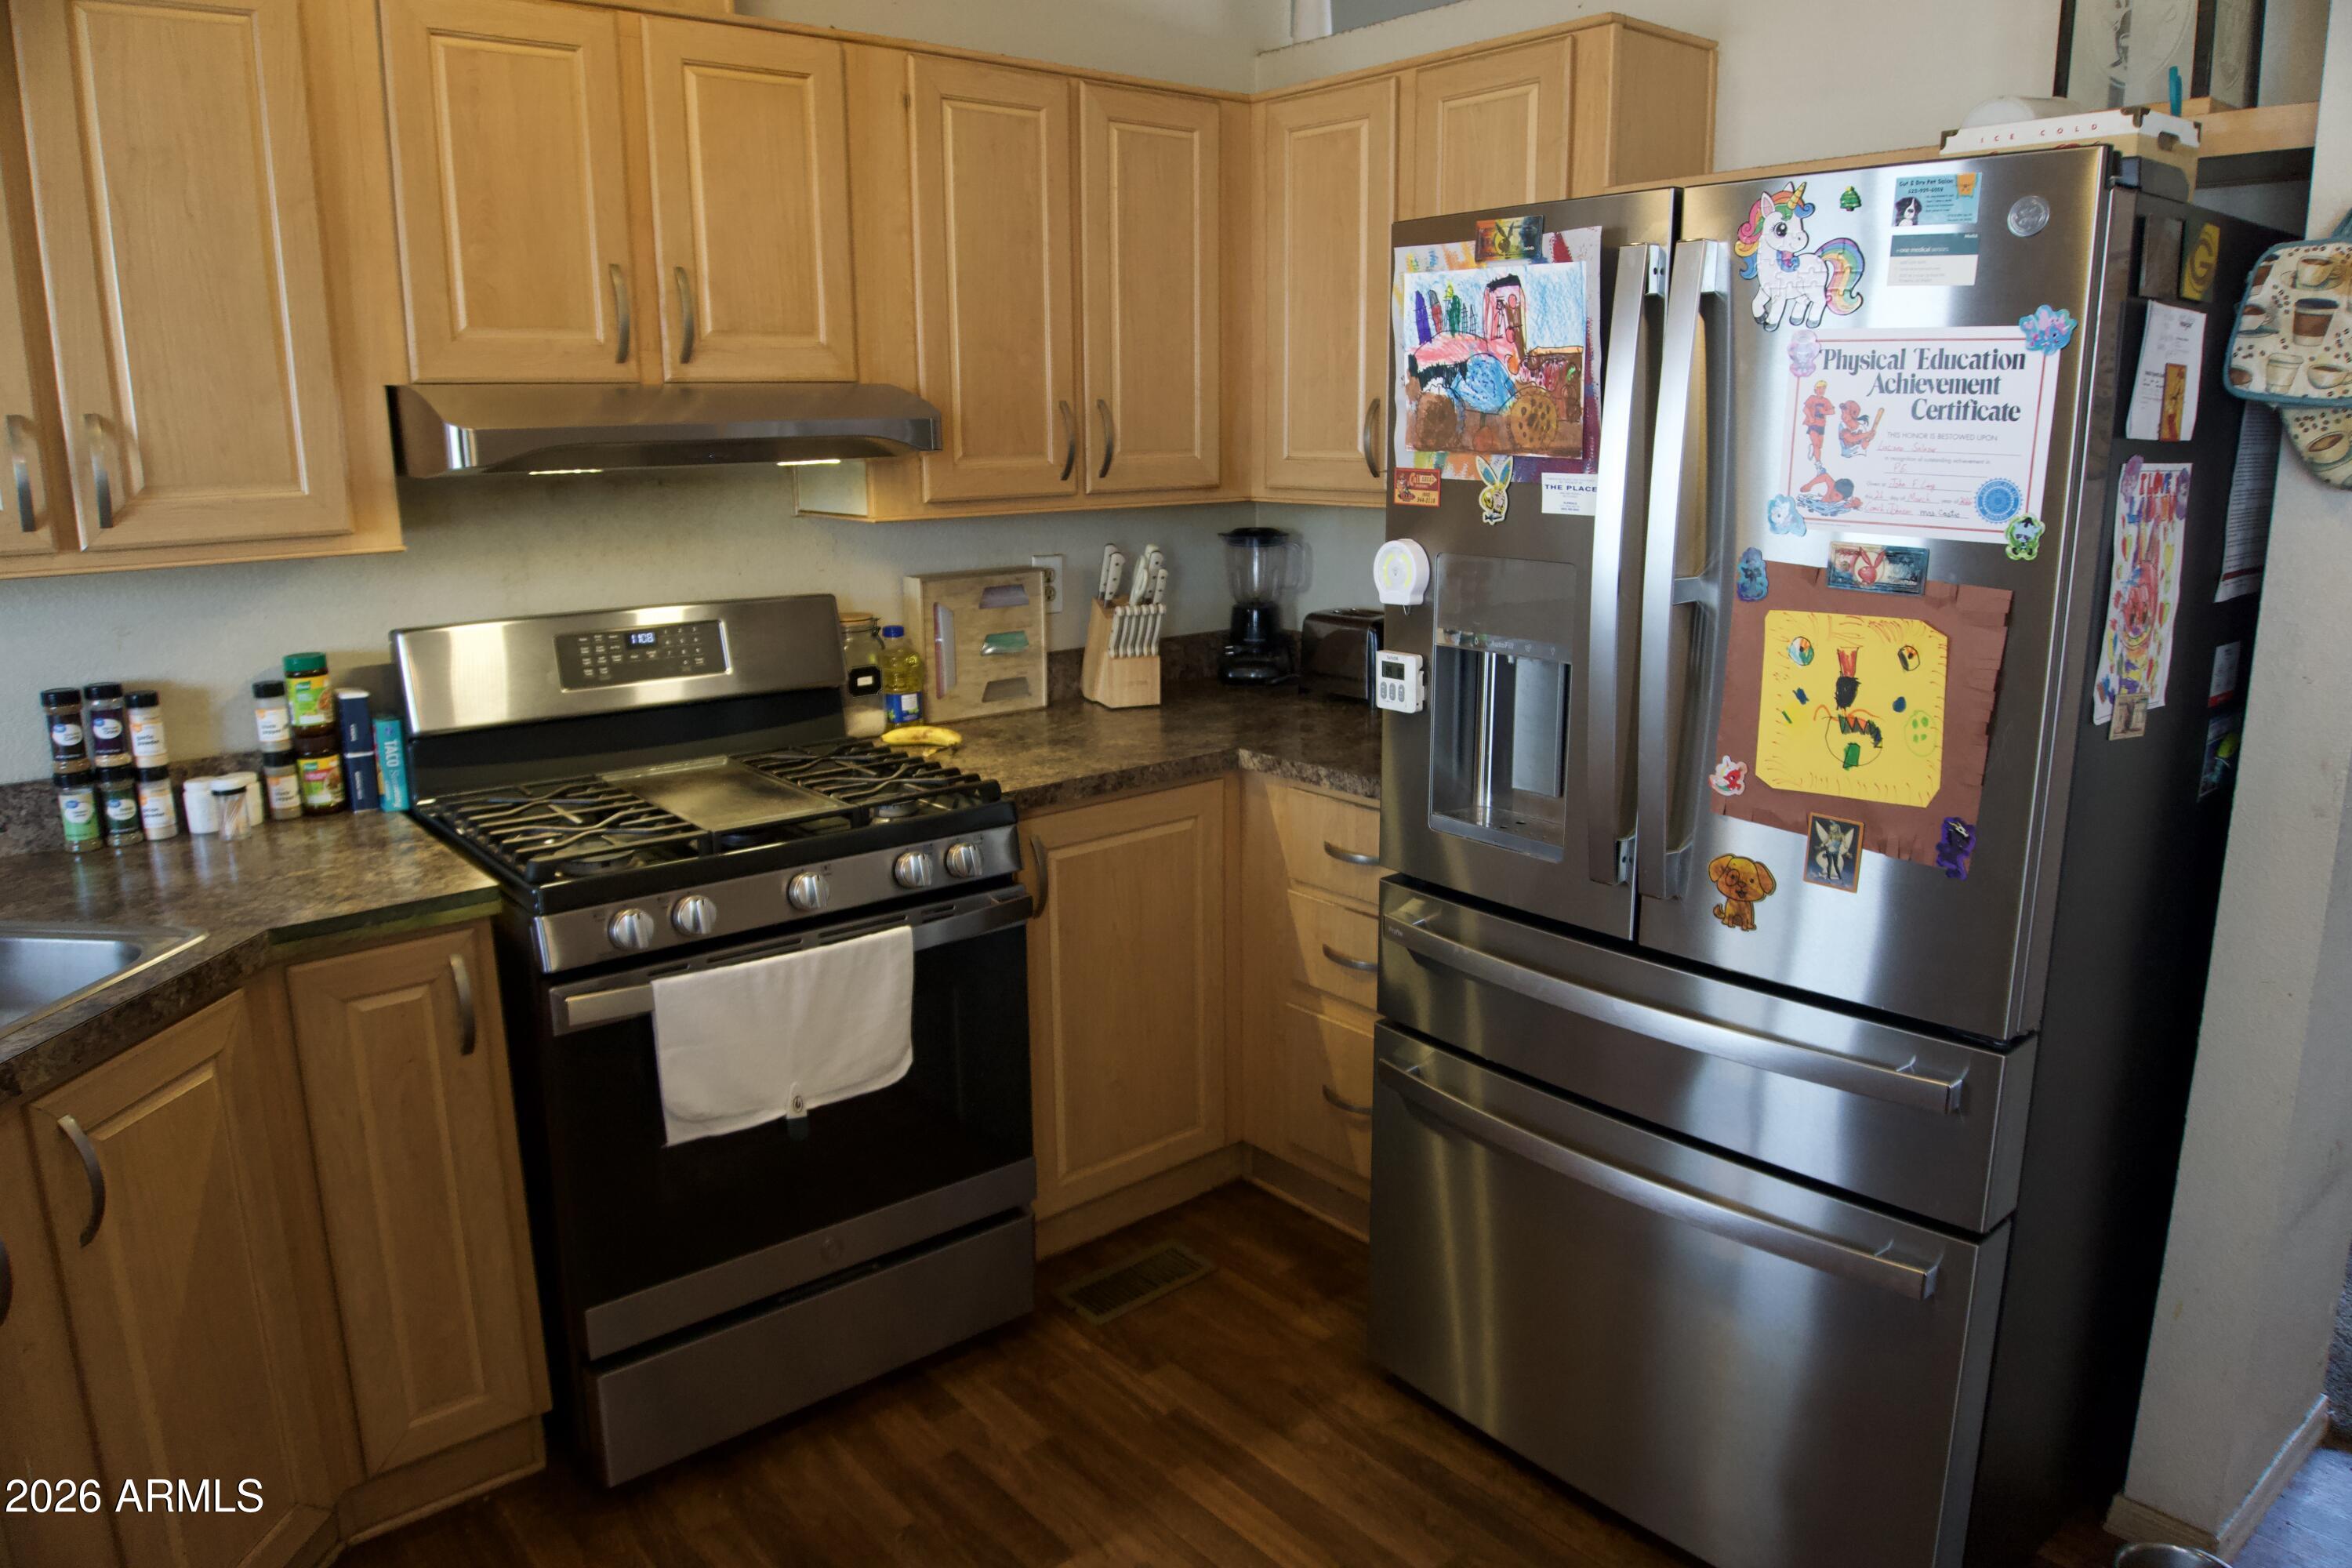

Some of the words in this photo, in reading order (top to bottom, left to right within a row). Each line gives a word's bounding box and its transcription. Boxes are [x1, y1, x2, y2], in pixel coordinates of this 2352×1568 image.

[1980, 133, 2014, 143] ICE
[2041, 124, 2097, 136] COLD
[1819, 348, 1906, 376] Physical
[1913, 348, 2026, 372] Education
[1867, 372, 2002, 397] Achievement
[1911, 398, 2021, 422] Certificate
[1491, 641, 1514, 650] AutoFill
[383, 739, 399, 768] TACO
